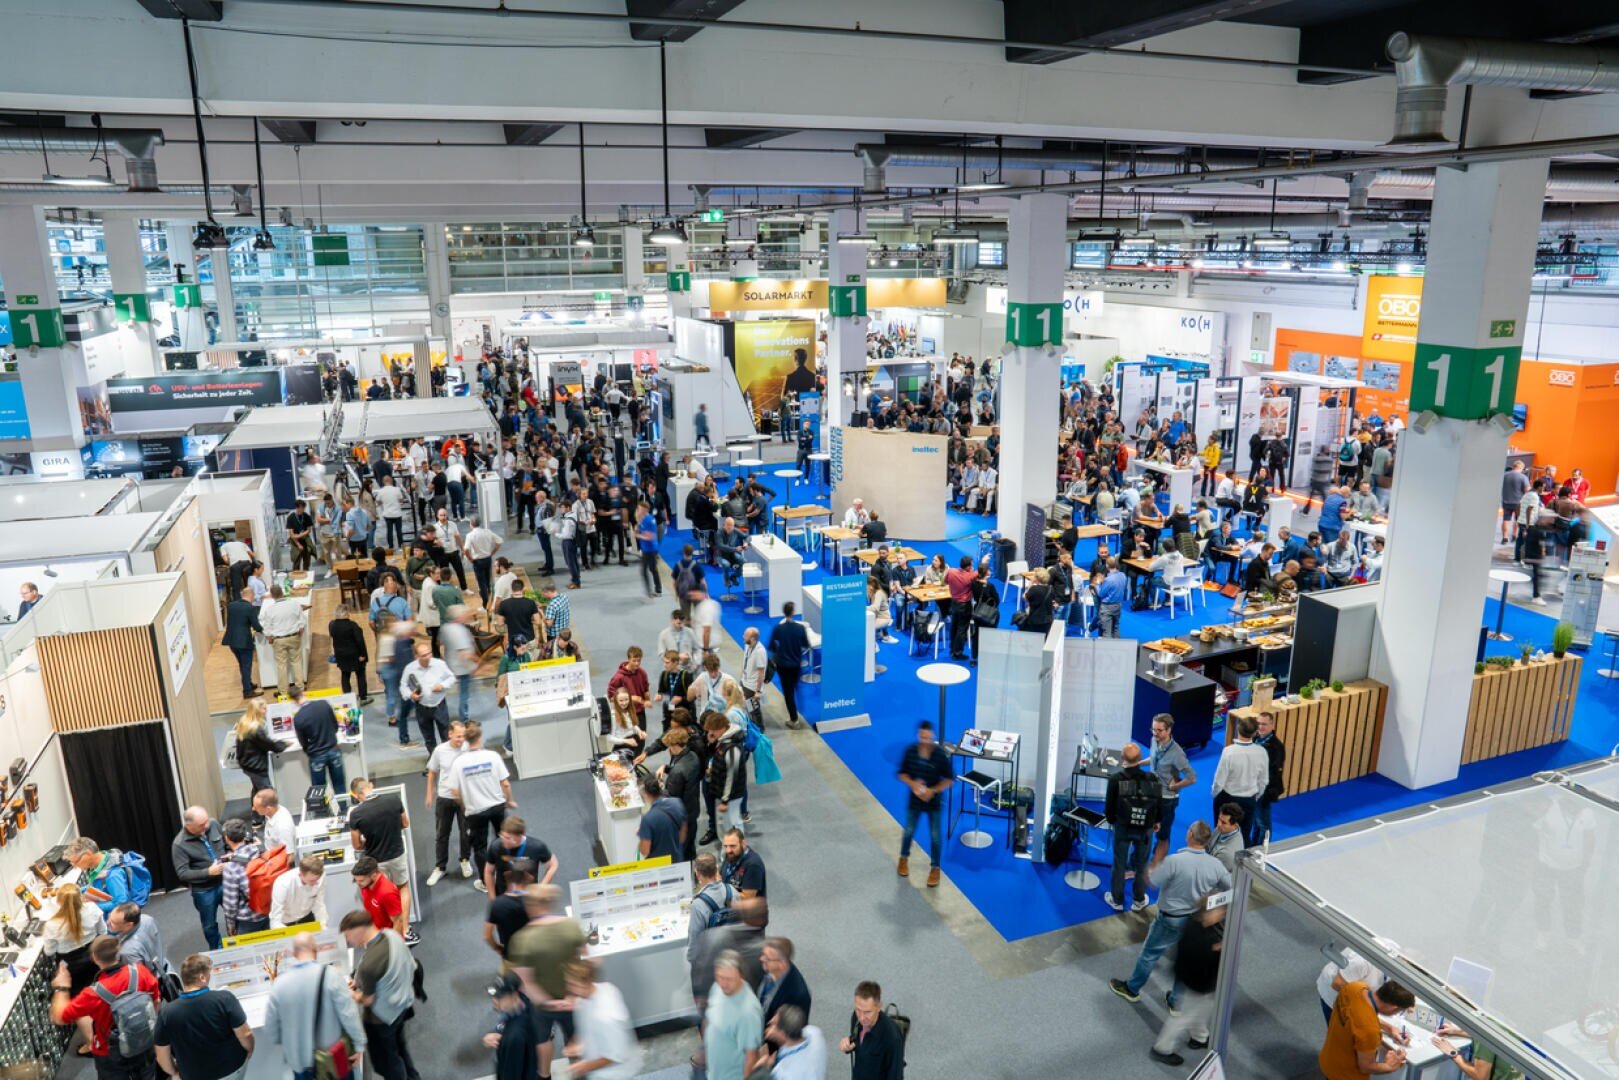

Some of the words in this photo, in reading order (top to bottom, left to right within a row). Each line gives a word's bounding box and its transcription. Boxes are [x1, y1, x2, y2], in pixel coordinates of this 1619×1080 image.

[676, 273, 684, 289] 1
[179, 287, 190, 306] 1
[743, 291, 814, 301] SOLARMARKT
[830, 292, 836, 312] 1
[846, 290, 857, 313] 1
[122, 297, 136, 318] 1
[1378, 299, 1421, 317] OBO
[20, 313, 40, 343] 1
[54, 312, 64, 342] 1
[1011, 307, 1020, 340] 1
[1036, 308, 1050, 341] 1
[1427, 353, 1452, 407] 1
[1484, 355, 1505, 409] 1
[1549, 371, 1576, 384] OBO
[173, 390, 208, 399] Sicherheit
[219, 390, 236, 399] jeder
[42, 457, 70, 466] GIRA
[826, 581, 863, 591] RESTAURANT
[823, 698, 856, 709] ineltec
